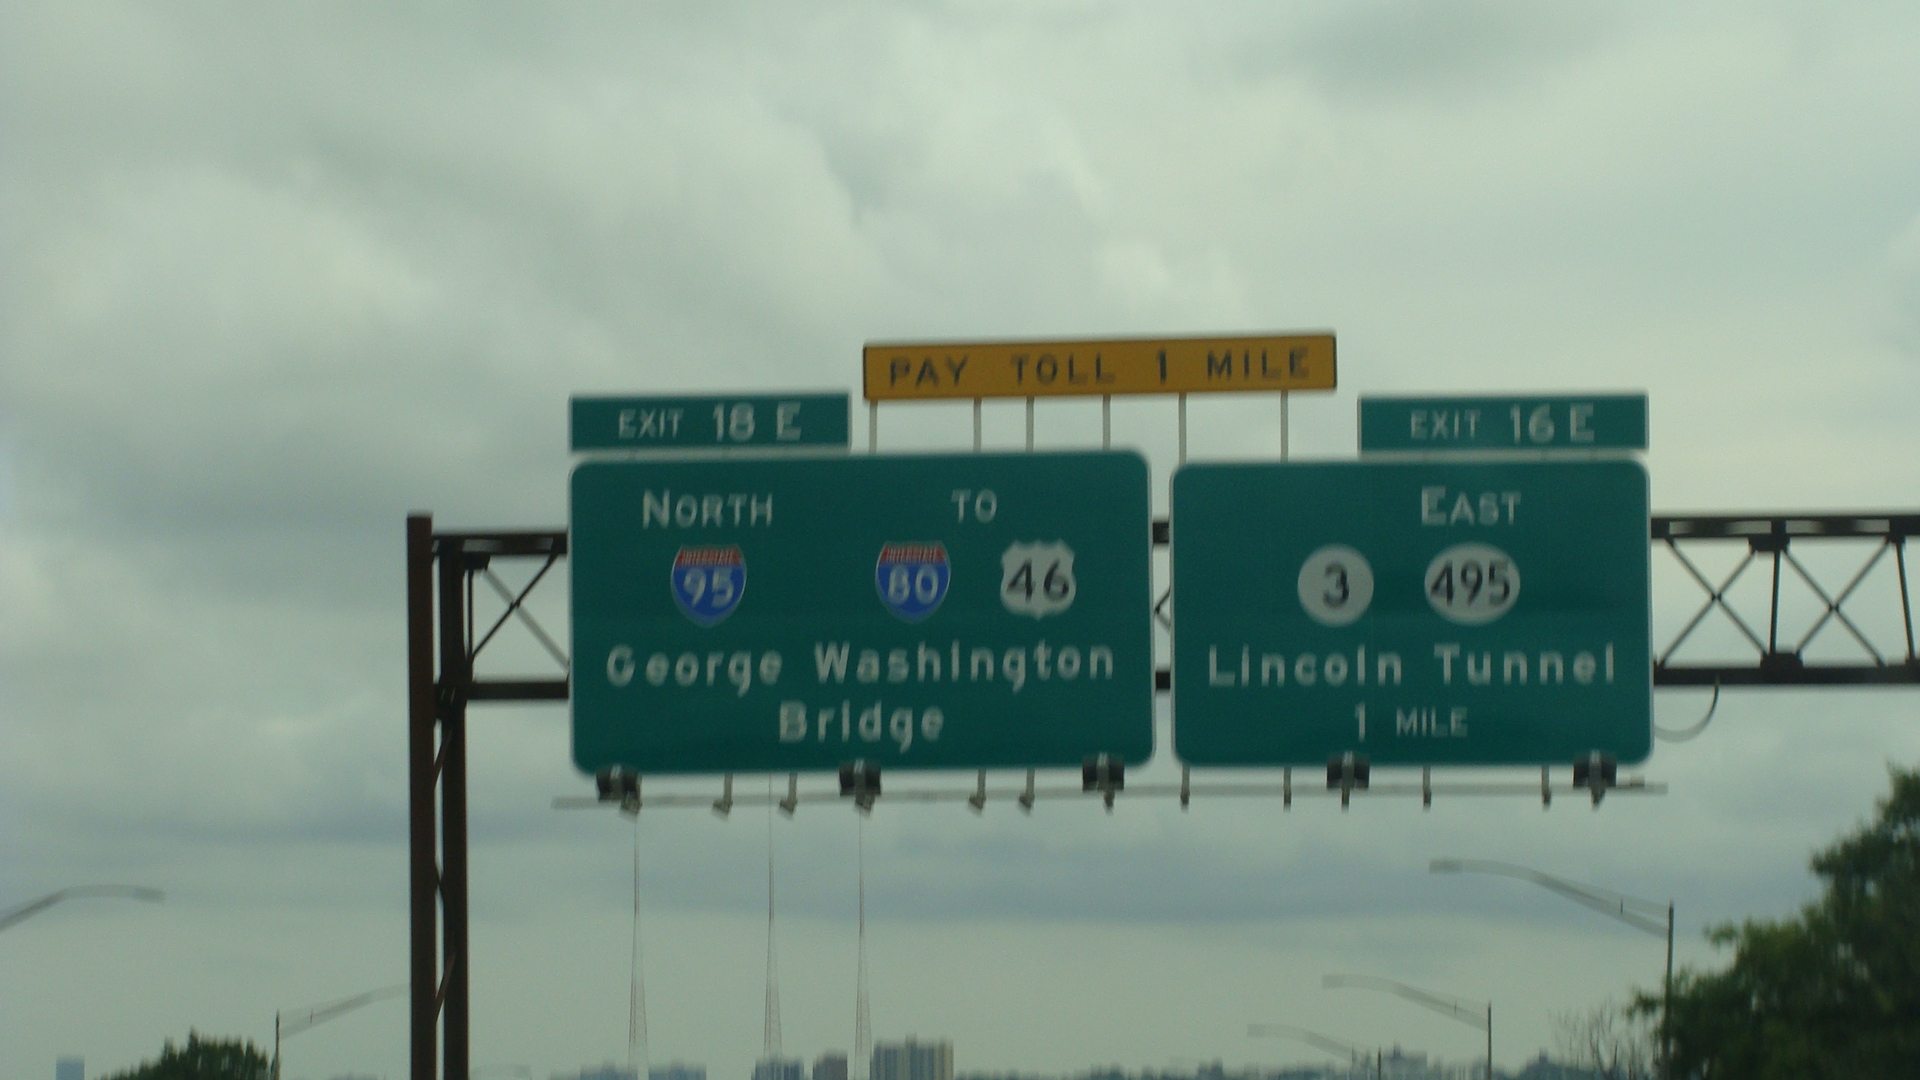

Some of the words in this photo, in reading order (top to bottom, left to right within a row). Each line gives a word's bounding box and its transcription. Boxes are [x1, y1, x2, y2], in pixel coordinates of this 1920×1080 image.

[890, 355, 968, 388] PAY
[1010, 352, 1116, 386] TOLL
[1155, 349, 1168, 385] 1
[1207, 347, 1310, 381] MILE
[618, 409, 684, 440] EXIT
[713, 404, 755, 442] 18
[776, 403, 803, 441] E
[1411, 409, 1480, 440] EXIT
[1509, 404, 1555, 443] 16
[1570, 403, 1596, 441] E
[642, 490, 774, 528] NORTH
[951, 490, 998, 523] TO
[1421, 486, 1521, 526] EAST
[683, 566, 734, 608] 95
[887, 564, 940, 604] 80
[1007, 558, 1071, 604] 46
[1323, 563, 1350, 608] 3
[1430, 561, 1511, 606] 495
[607, 645, 782, 697] George
[815, 641, 1114, 691] Washington
[1209, 645, 1402, 686] Lincoln
[1434, 643, 1614, 685] Tunnel
[780, 701, 944, 753] Bridge
[1355, 705, 1366, 741] 1
[1396, 707, 1468, 737] MILE
